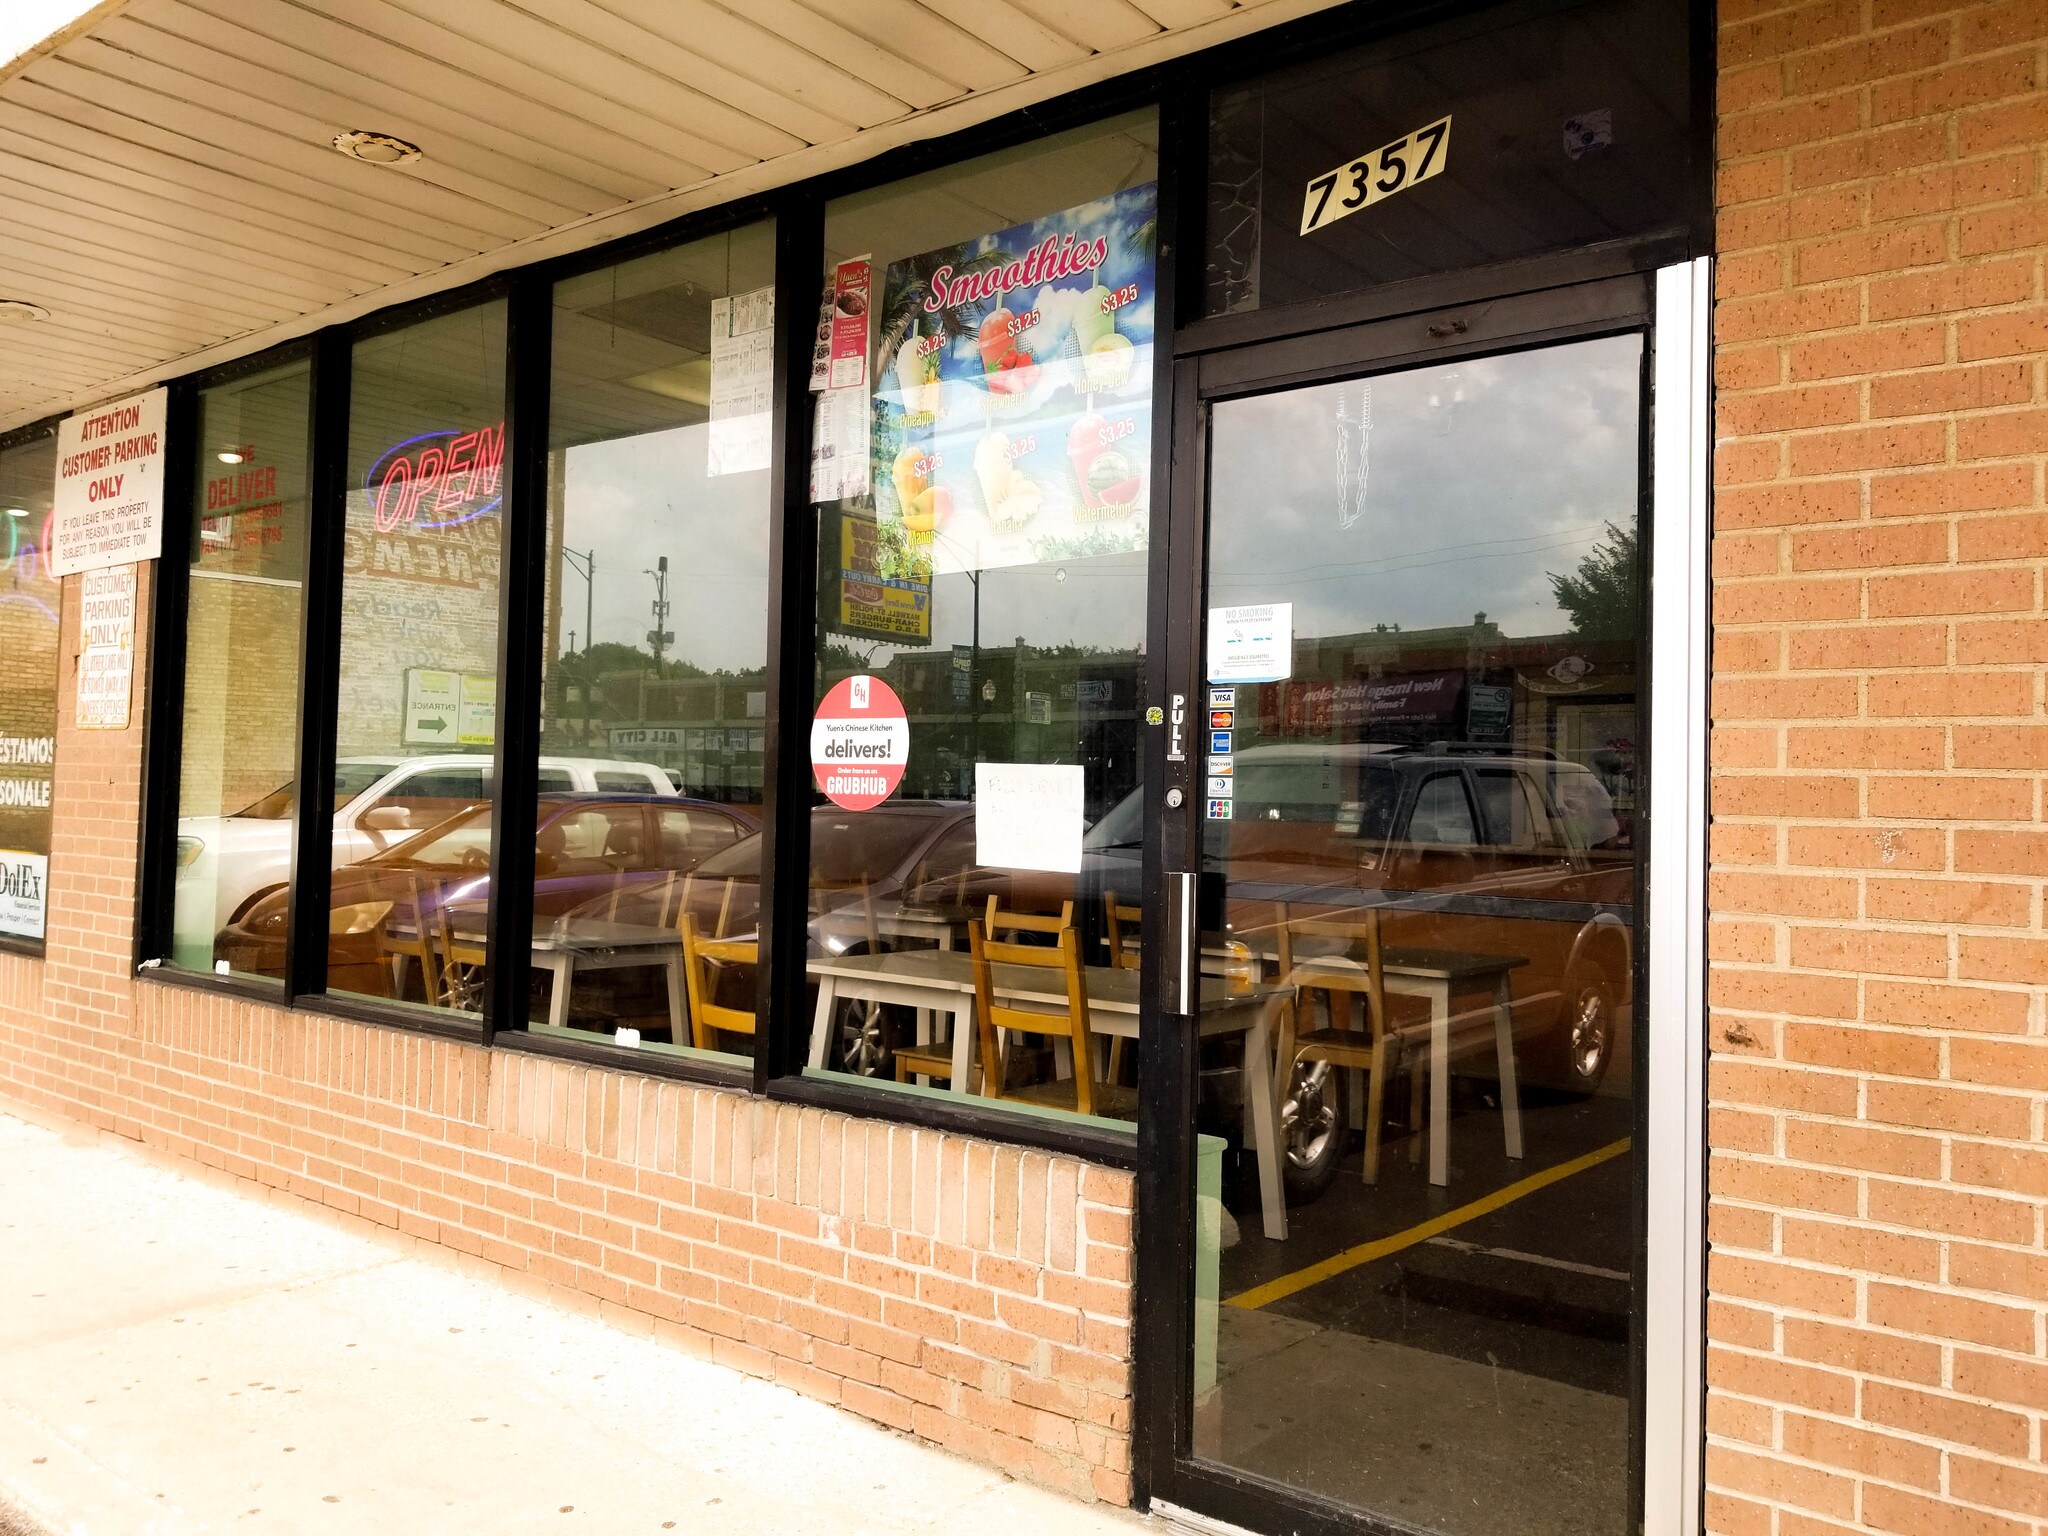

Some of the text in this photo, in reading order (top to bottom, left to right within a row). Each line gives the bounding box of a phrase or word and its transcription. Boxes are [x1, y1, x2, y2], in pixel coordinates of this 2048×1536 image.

[1306, 120, 1447, 230] 7357
[924, 231, 1108, 313] Smoothies
[1101, 283, 1138, 316] $3.25
[1007, 308, 1041, 339] $3.25
[916, 331, 947, 361] $3.25
[1075, 370, 1129, 396] Honey-Dew
[980, 391, 1029, 414] Strawberry
[81, 405, 140, 442] ATTENTION
[900, 410, 939, 429] Pineapple
[1098, 417, 1136, 447] $3.25
[62, 432, 158, 479] CUSTOMER PARKING
[1003, 435, 1036, 463] $3.25
[375, 422, 505, 533] OPEN
[913, 452, 944, 479] $3.25
[88, 473, 125, 502] ONLY
[208, 466, 276, 510] DELIVER
[63, 501, 149, 530] IF YOU LEAVE THIS PROPERTY
[1073, 501, 1131, 524] Watermelon
[59, 516, 152, 546] FOR ANY REASON YOU WILL BE
[909, 530, 937, 547] Mango
[990, 518, 1023, 536] Banana
[62, 533, 147, 560] SUBJECT TO IMMEDIATE TOW
[85, 572, 132, 596] CUSTOMER
[85, 598, 130, 621] PARKING
[1225, 606, 1274, 619] NO SMOKING
[90, 623, 121, 645] ONLY
[1214, 694, 1232, 702] VISA
[826, 723, 893, 732] Yuen's Chinese Kitchen
[1171, 694, 1185, 755] PULL
[825, 739, 892, 759] delivers!
[826, 776, 887, 795] GRUBHUB
[1211, 803, 1229, 815] JCB
